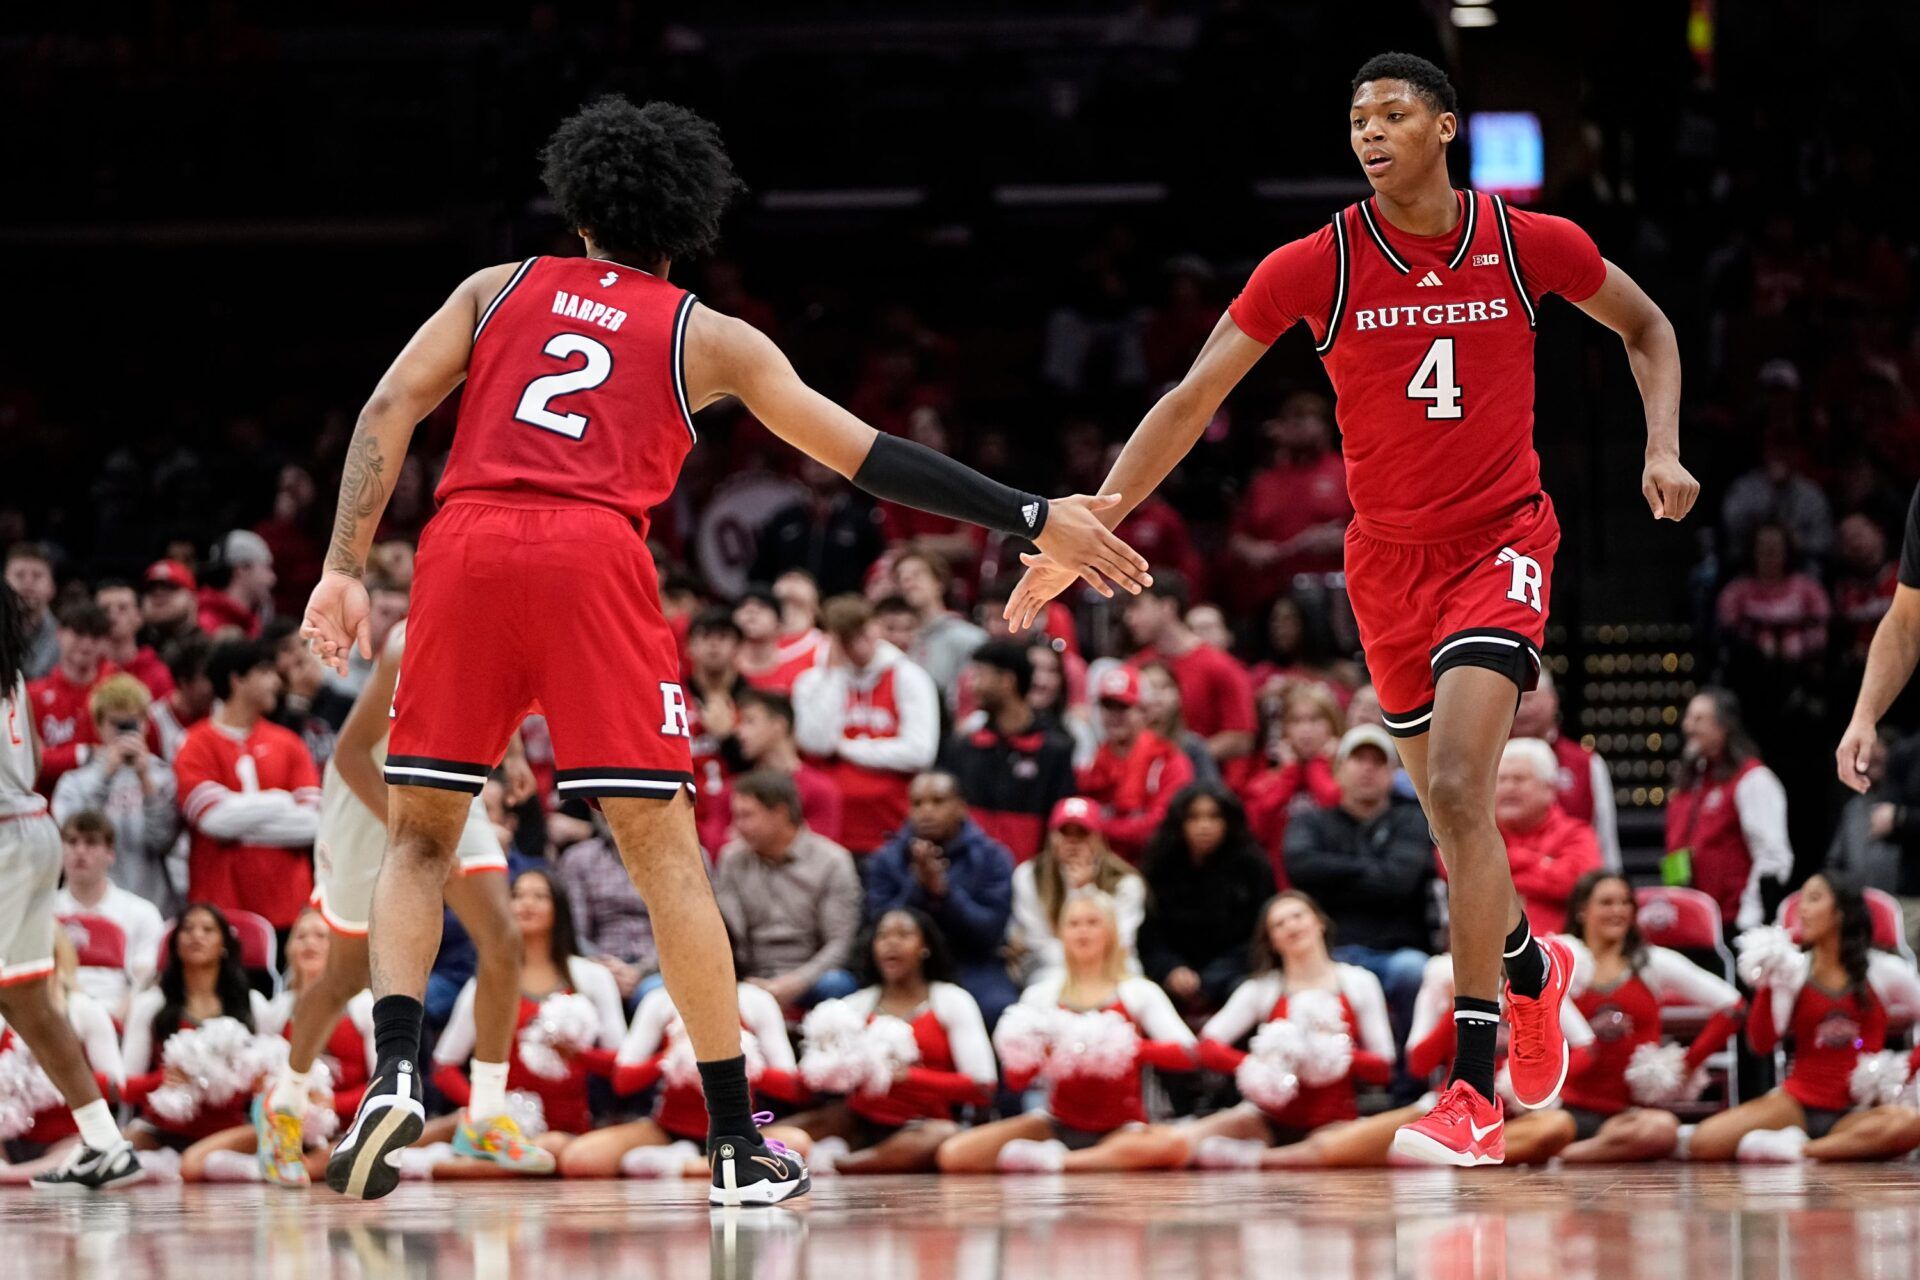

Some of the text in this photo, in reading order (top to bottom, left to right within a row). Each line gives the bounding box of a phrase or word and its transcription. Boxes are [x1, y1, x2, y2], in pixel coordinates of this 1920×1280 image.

[551, 290, 628, 332] HARPER
[1355, 298, 1509, 331] RUTGERS
[514, 332, 613, 441] 2
[1406, 337, 1462, 420] 4
[1505, 554, 1543, 614] R
[659, 681, 690, 738] R
